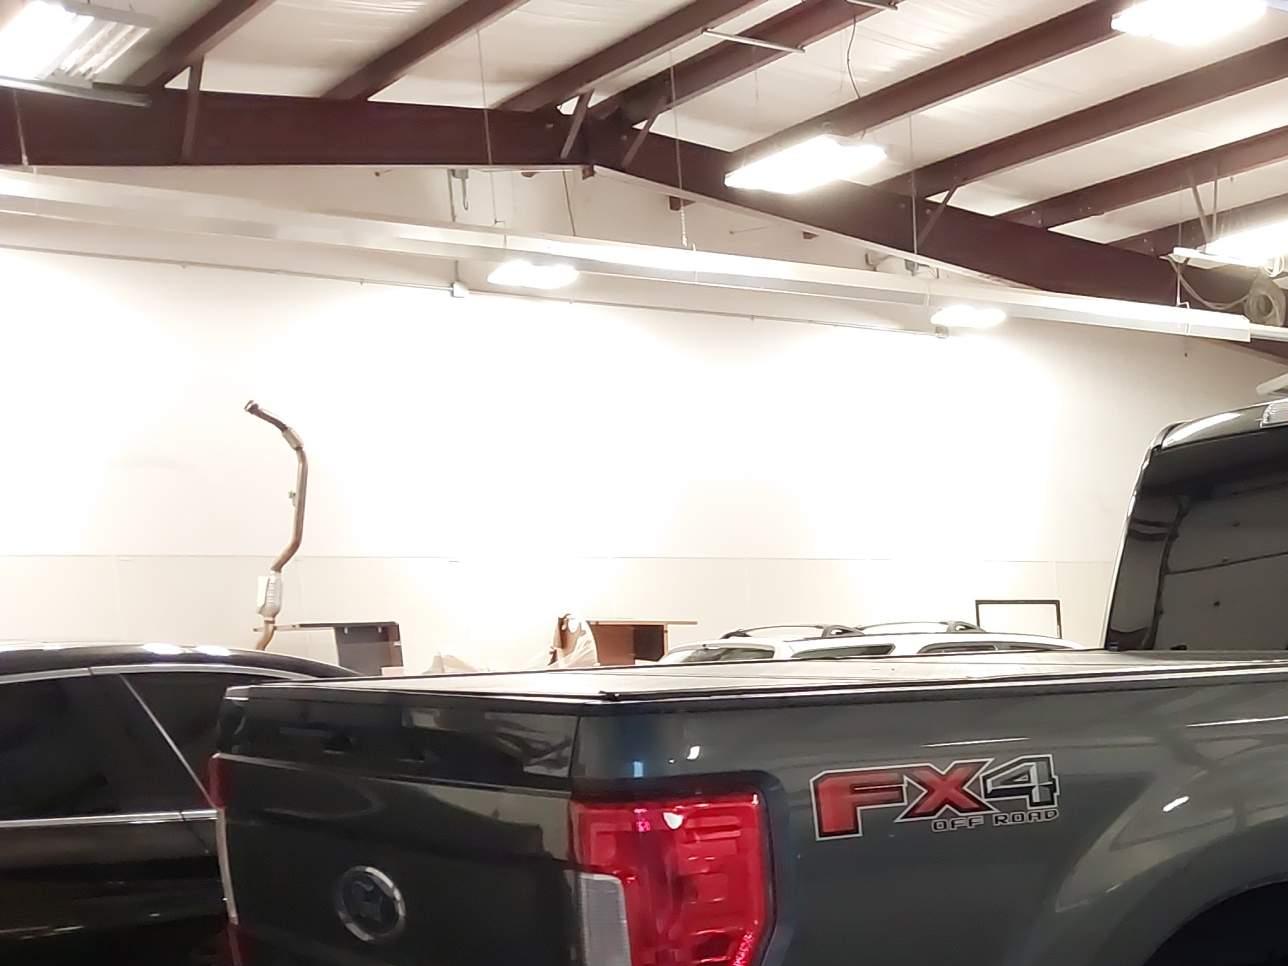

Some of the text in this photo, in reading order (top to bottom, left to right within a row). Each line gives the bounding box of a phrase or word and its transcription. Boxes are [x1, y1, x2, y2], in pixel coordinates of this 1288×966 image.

[809, 754, 1060, 841] FX4
[931, 808, 1060, 832] OFF ROAD
